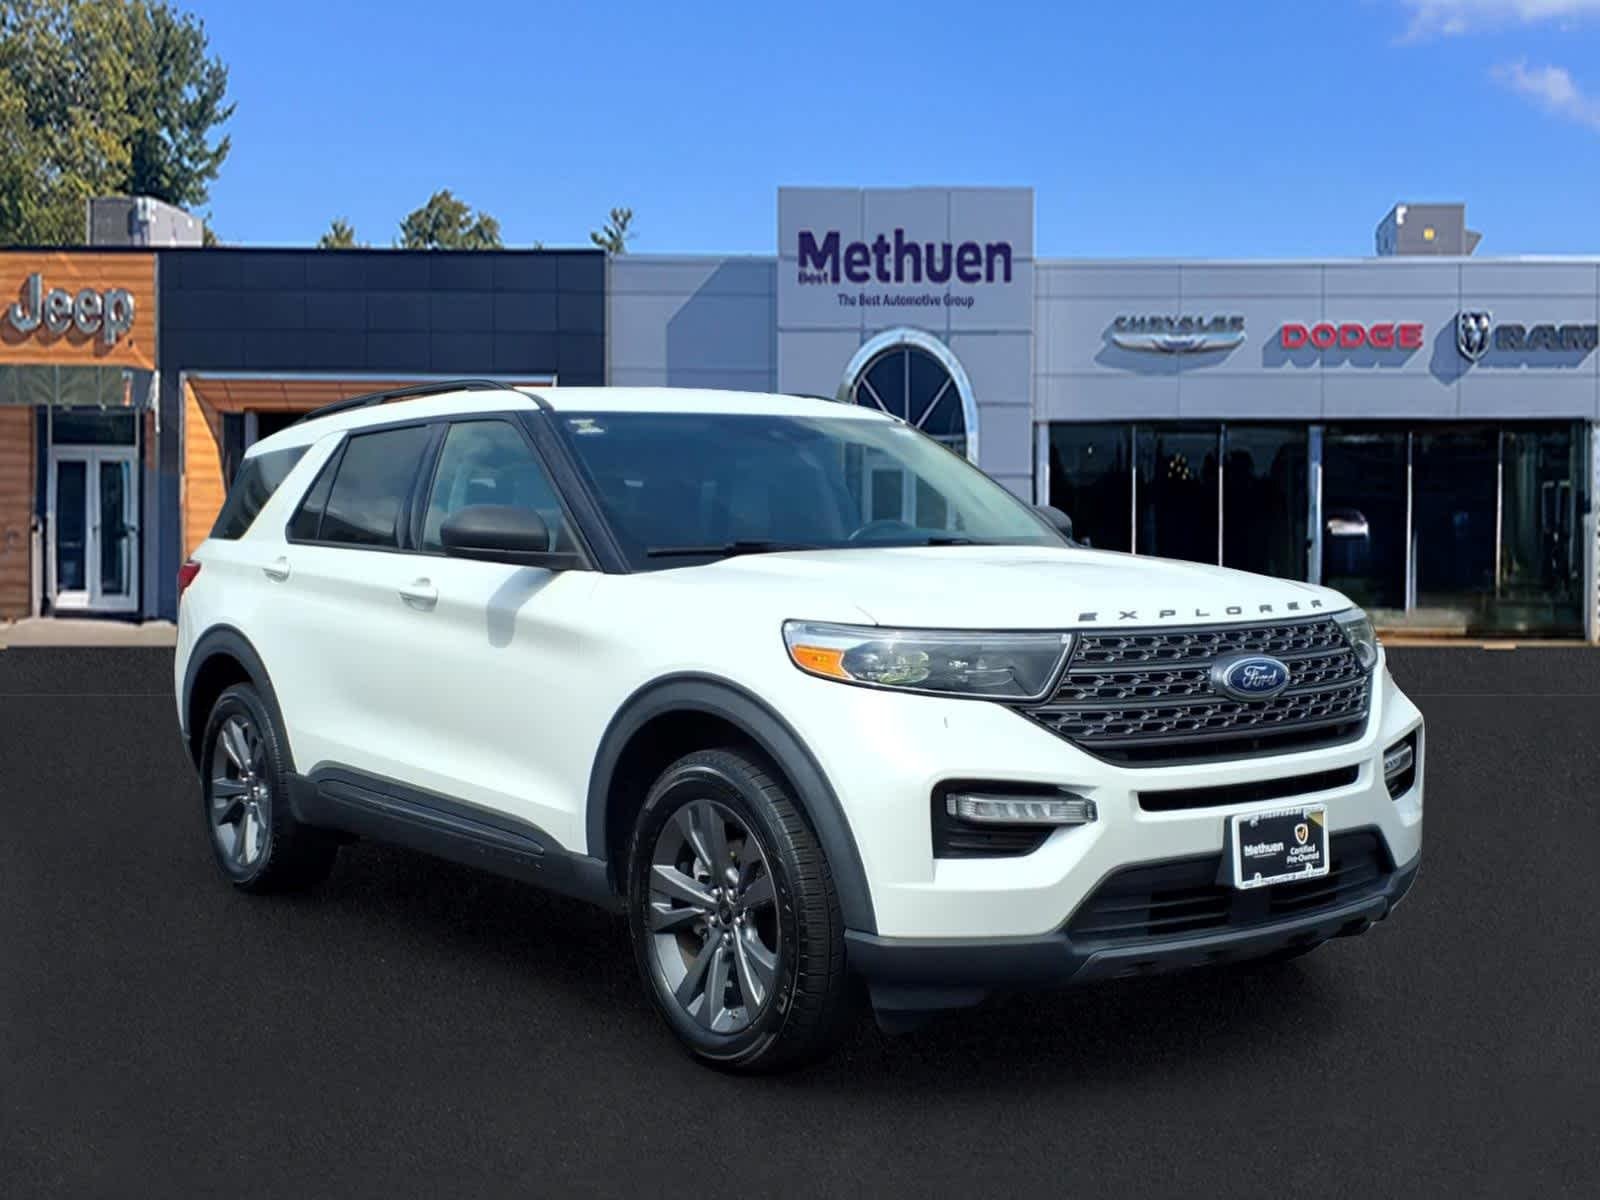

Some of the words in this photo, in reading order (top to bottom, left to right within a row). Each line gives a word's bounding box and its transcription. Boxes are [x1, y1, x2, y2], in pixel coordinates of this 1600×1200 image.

[798, 228, 1012, 283] Methuen
[798, 272, 829, 284] Best
[9, 273, 135, 345] Jeep
[838, 293, 856, 307] The
[859, 293, 881, 307] Best
[883, 293, 941, 307] Automotive
[943, 293, 974, 309] Group
[1282, 323, 1423, 349] DODGE
[1495, 325, 1599, 350] RAM
[1078, 599, 1322, 622] EXPLORER
[1242, 665, 1277, 689] Ford
[1243, 842, 1284, 857] Methuen
